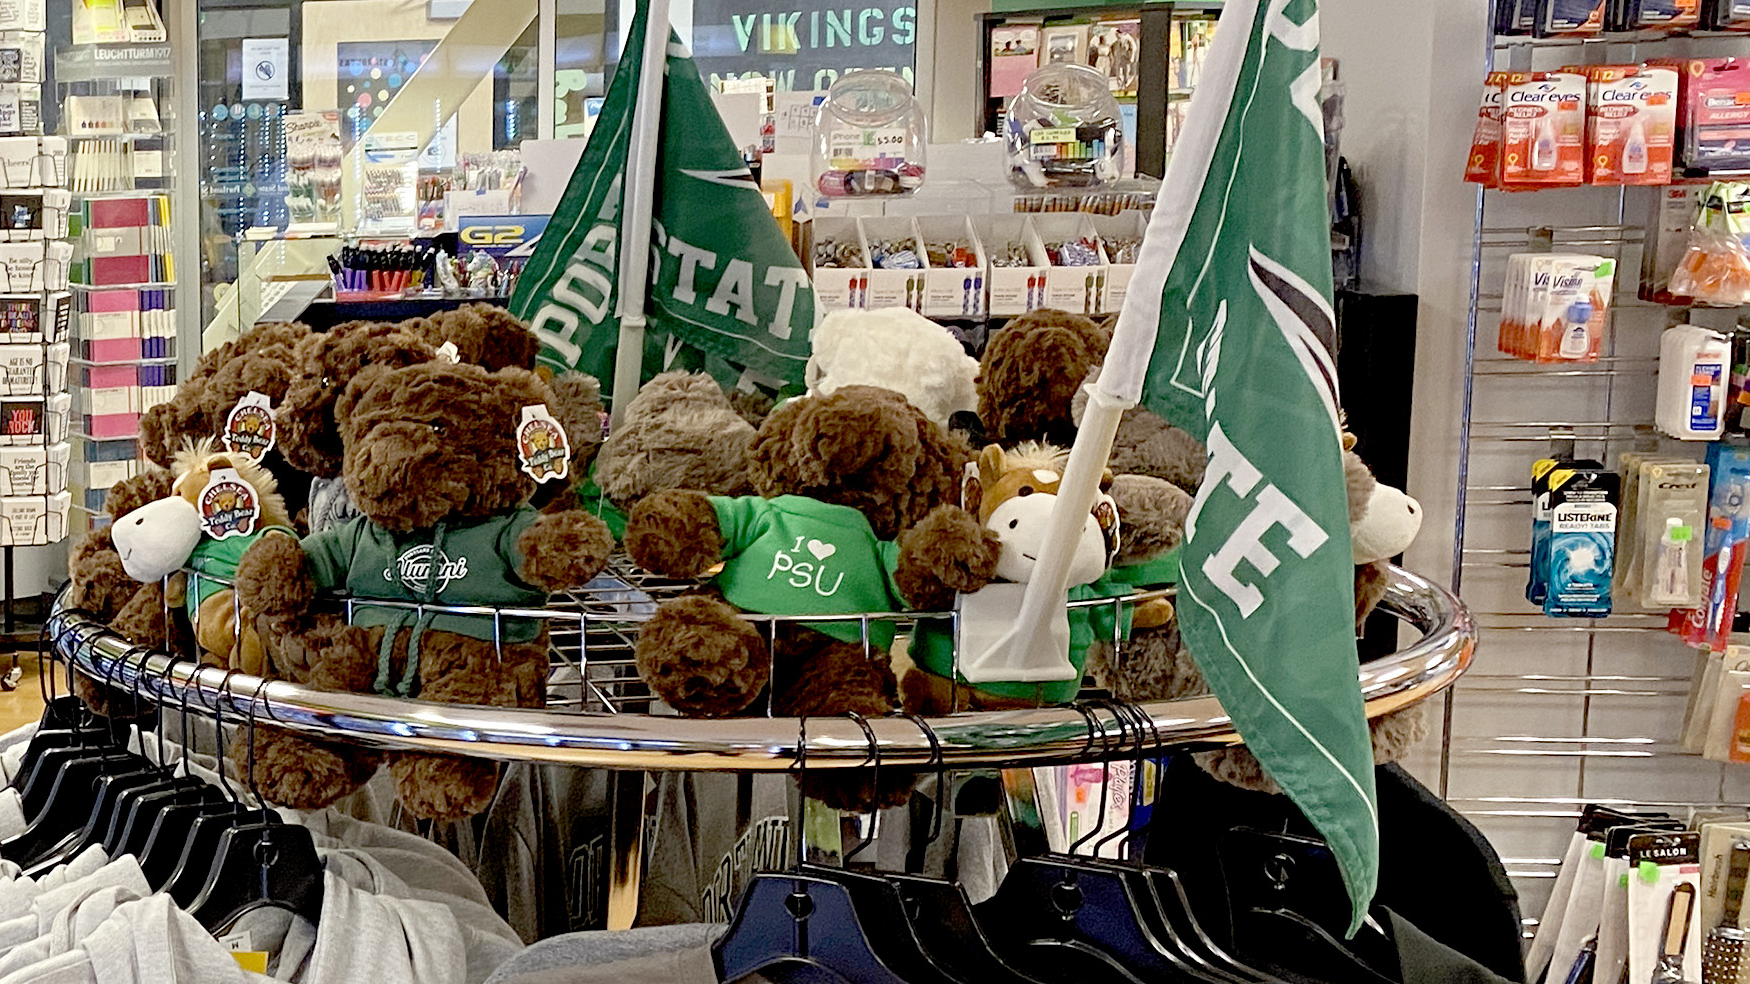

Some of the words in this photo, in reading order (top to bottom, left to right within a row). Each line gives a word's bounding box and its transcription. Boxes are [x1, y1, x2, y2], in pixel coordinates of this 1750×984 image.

[732, 7, 916, 52] VIKINGS
[94, 47, 171, 60] LEUCHTTURM1917
[1511, 92, 1547, 103] Clear
[1549, 93, 1581, 106] eyes
[1602, 90, 1636, 101] Clear
[1709, 111, 1749, 120] ALLERGY
[460, 225, 525, 244] G2
[235, 407, 271, 430] CHELSEA
[204, 483, 249, 505] CHELSEA
[1558, 512, 1613, 522] LISTERINE
[791, 536, 805, 552] I
[767, 550, 844, 596] PSU
[1692, 569, 1713, 629] Colgate
[1653, 847, 1687, 857] SALON
